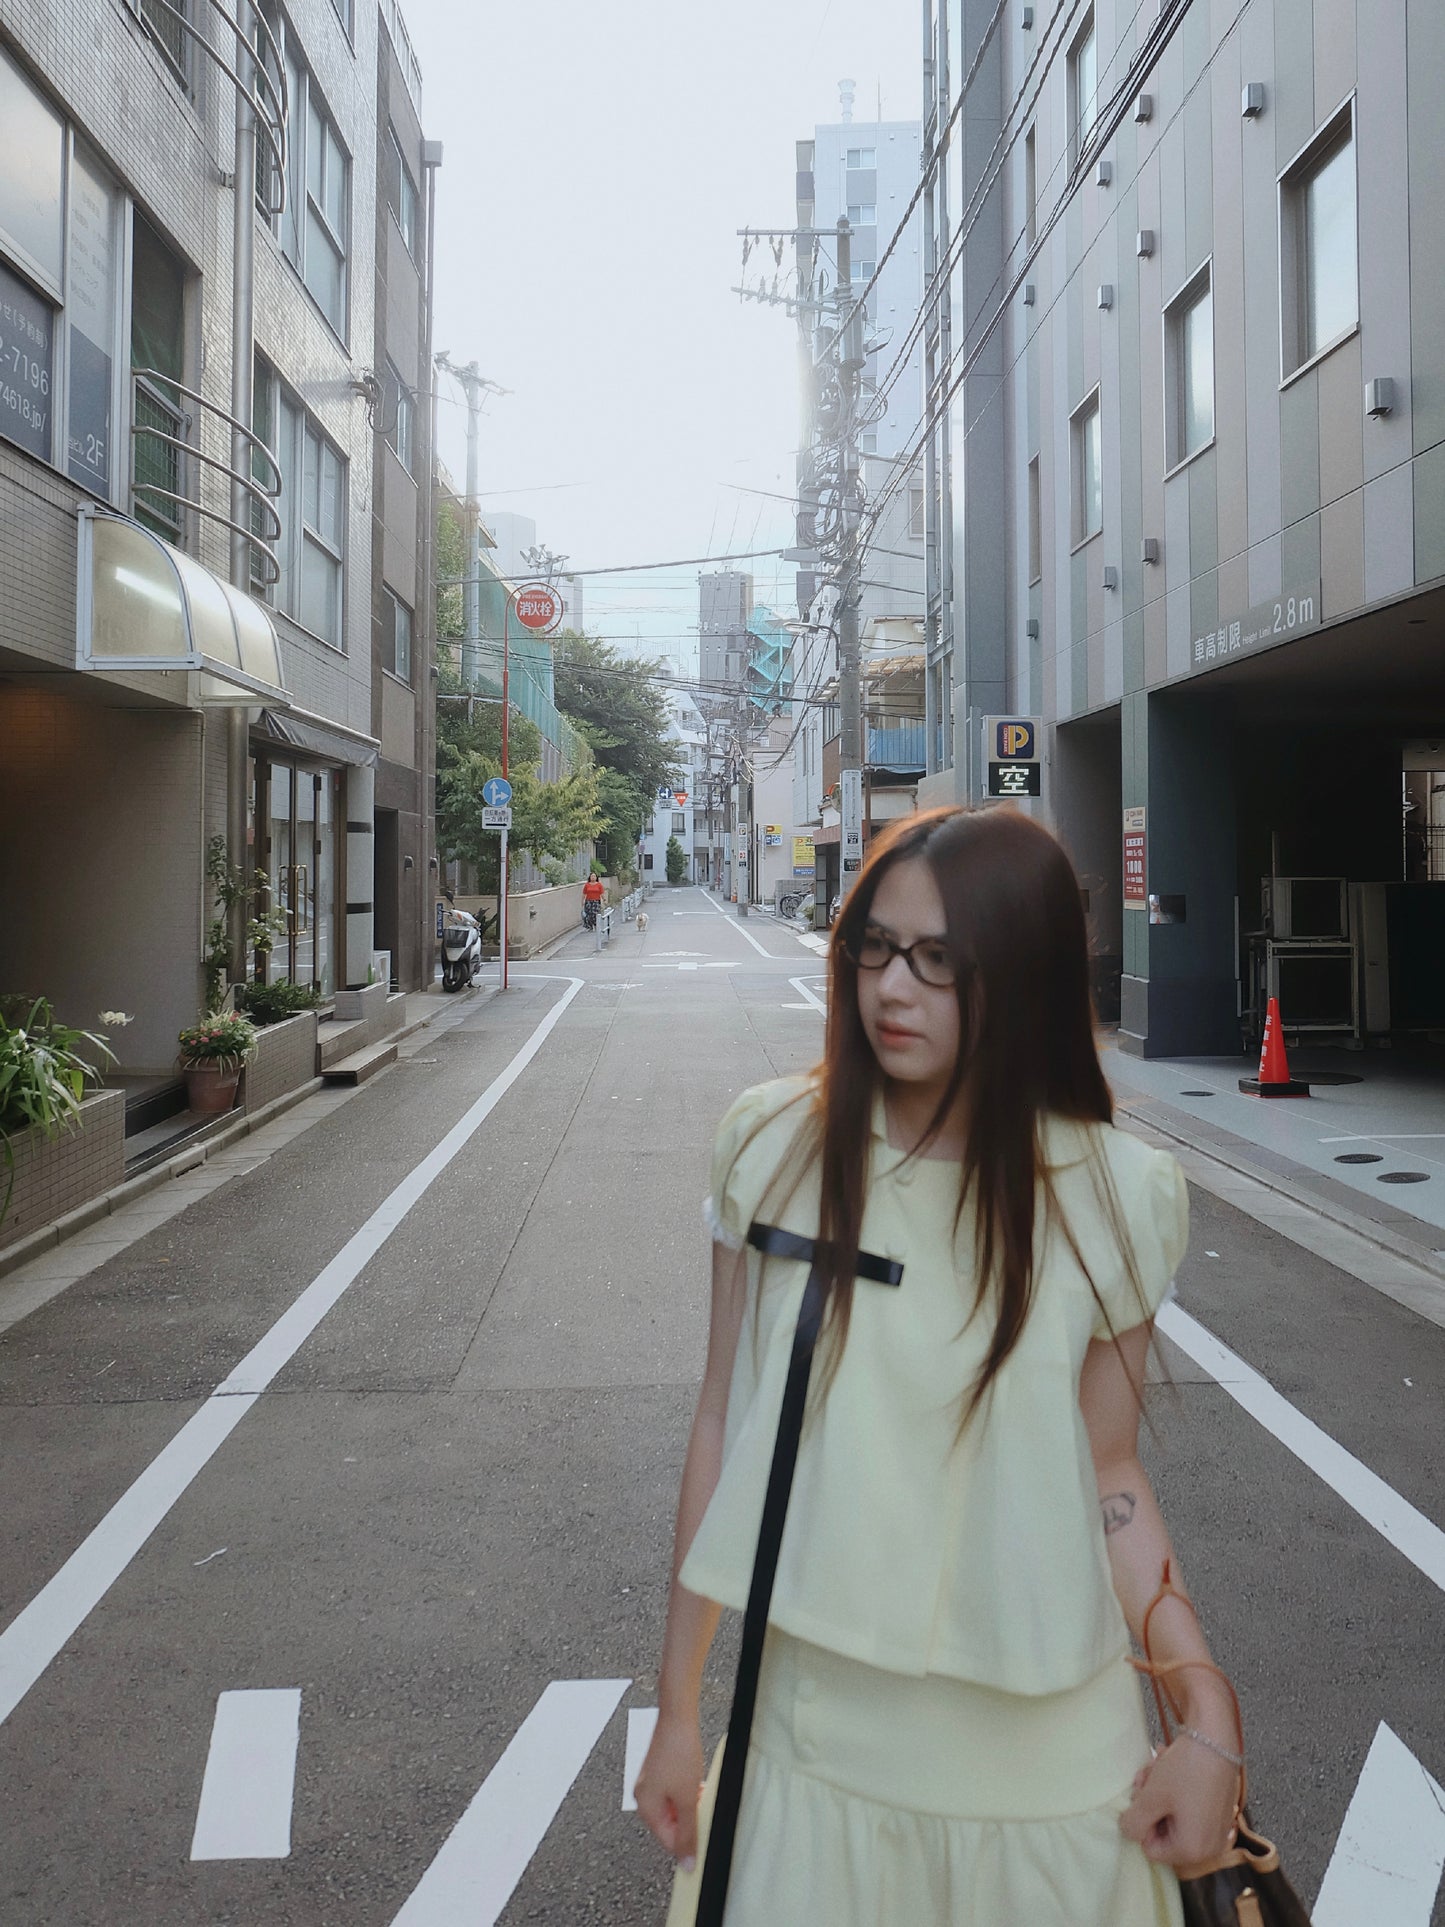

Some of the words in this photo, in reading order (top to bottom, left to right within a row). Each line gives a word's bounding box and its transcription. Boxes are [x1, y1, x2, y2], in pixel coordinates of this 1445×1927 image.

[86, 433, 104, 467] 2F
[519, 601, 552, 617] 消火栓
[1194, 620, 1241, 663] 車高制限
[1008, 725, 1029, 755] P
[998, 765, 1029, 794] 空
